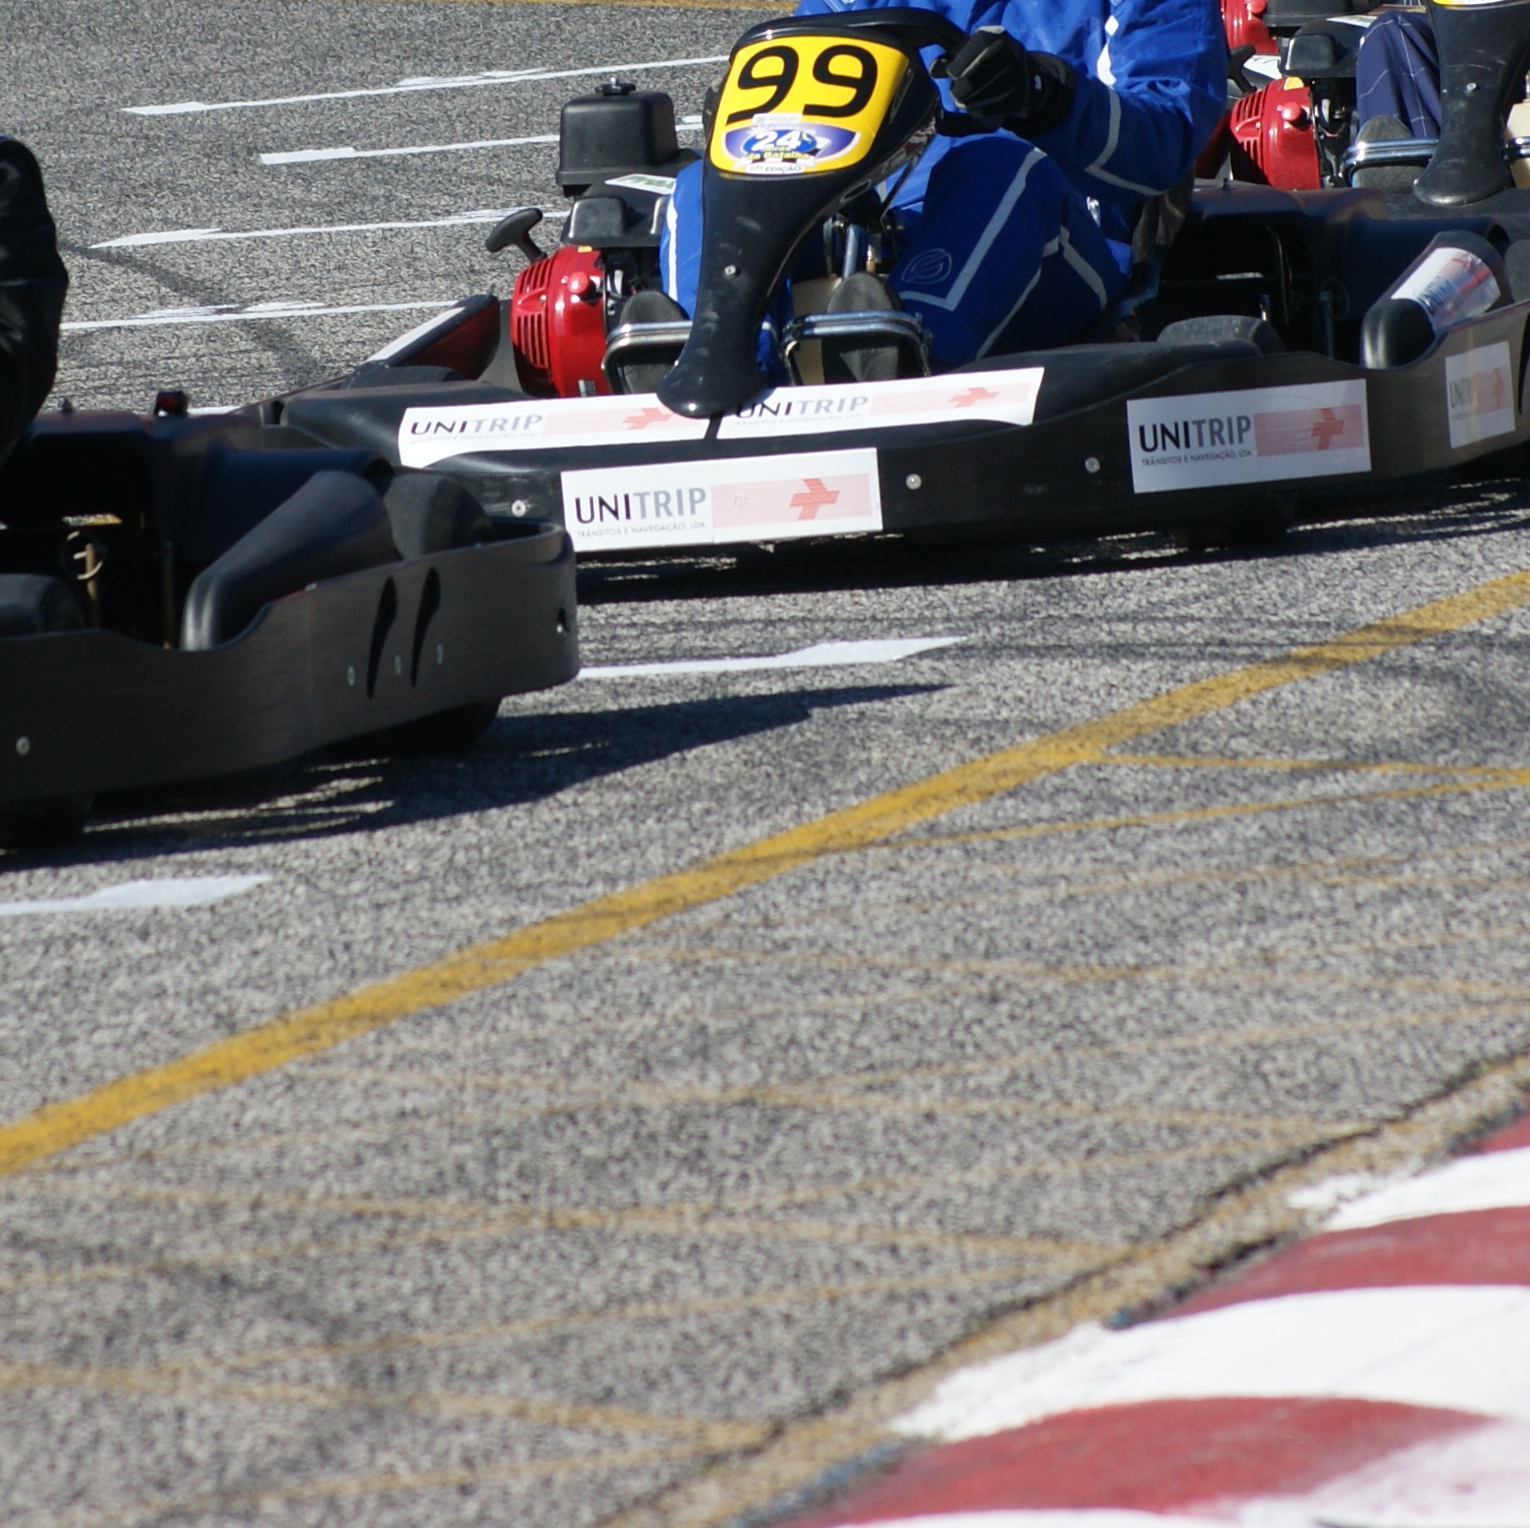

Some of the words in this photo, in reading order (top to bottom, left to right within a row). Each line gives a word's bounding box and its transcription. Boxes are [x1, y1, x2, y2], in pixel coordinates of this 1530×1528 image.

[724, 44, 879, 126] 99
[410, 415, 544, 436] UNITRIP
[1138, 415, 1252, 453] UNITRIP
[574, 487, 707, 524] UNITRIP
